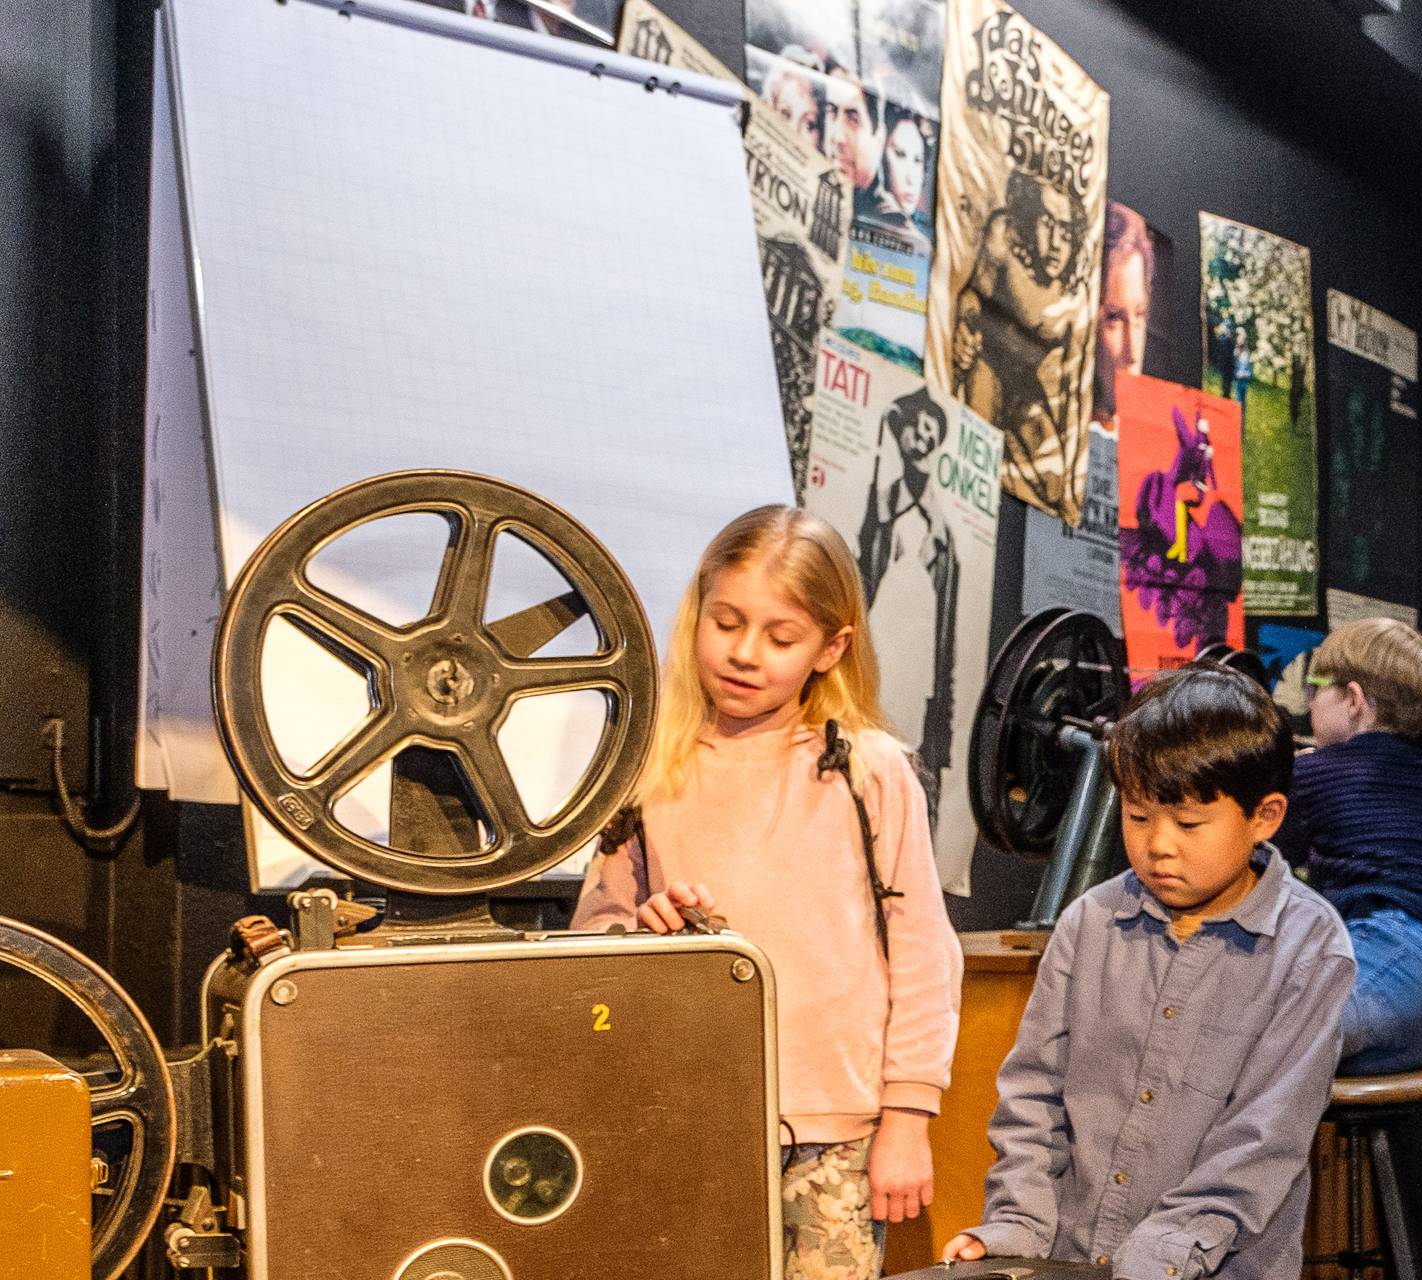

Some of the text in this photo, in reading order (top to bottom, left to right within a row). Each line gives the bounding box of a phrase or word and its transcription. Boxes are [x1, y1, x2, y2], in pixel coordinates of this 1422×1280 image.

[821, 349, 871, 408] TATI
[959, 423, 1000, 480] MEIN
[938, 453, 995, 518] ONKEL
[591, 1004, 611, 1031] 2
